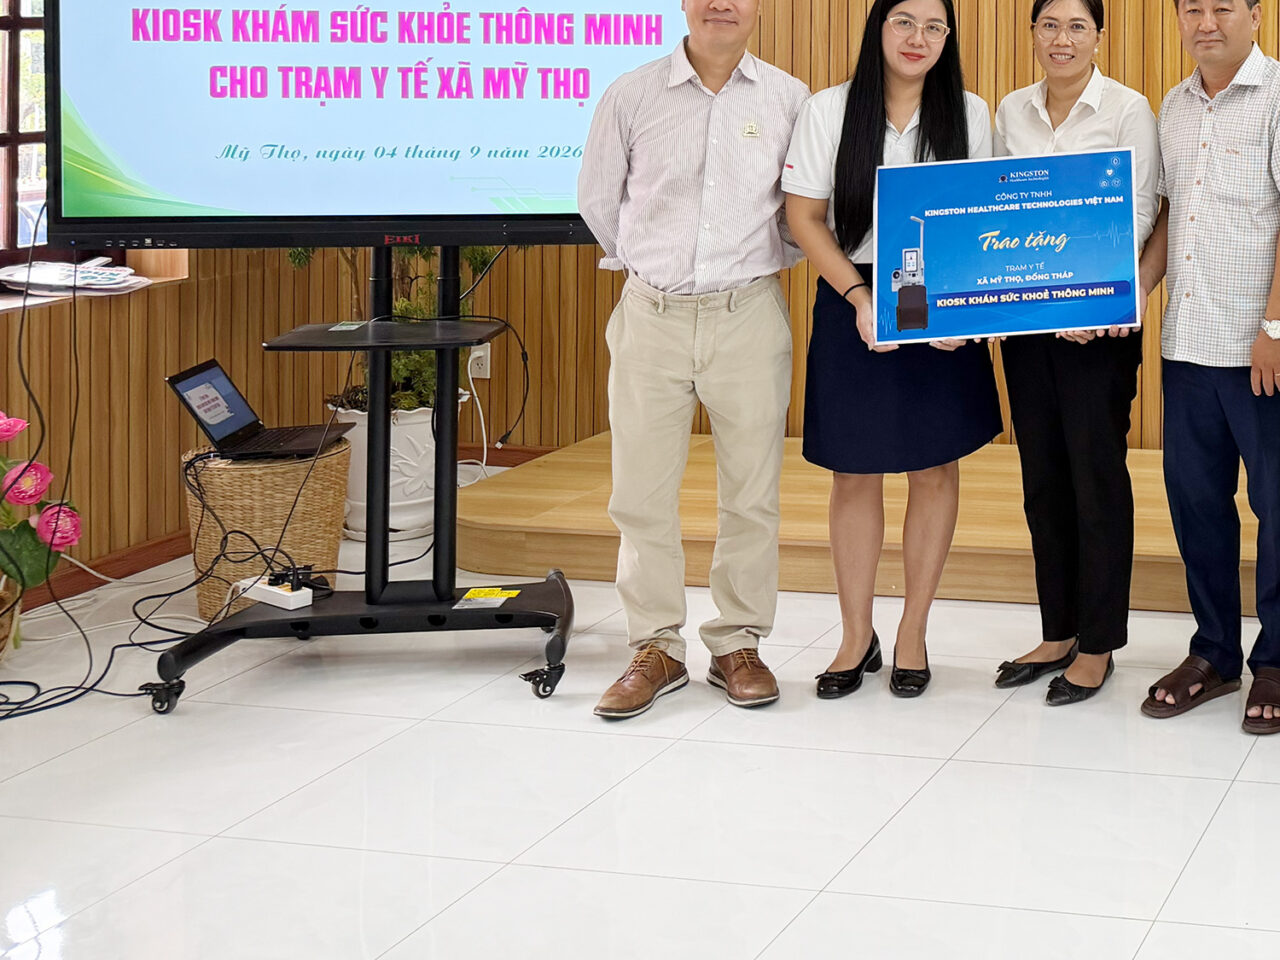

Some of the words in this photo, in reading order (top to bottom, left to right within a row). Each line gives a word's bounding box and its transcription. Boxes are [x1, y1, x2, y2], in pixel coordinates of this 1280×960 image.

[131, 8, 223, 42] KIOSK
[232, 4, 320, 42] KHÁM
[330, 4, 388, 44] SỨC
[398, 2, 471, 44] KHỎE
[478, 6, 574, 45] THÔNG
[584, 13, 662, 46] MINH
[209, 66, 268, 98] CHO
[277, 66, 362, 107] TRẠM
[370, 66, 389, 99] Y
[397, 56, 434, 99] TẾ
[436, 61, 474, 99] XÃ
[482, 61, 529, 99] MỸ
[536, 68, 590, 108] THỌ
[215, 144, 250, 162] Mỹ
[259, 144, 308, 162] Thọ,
[315, 146, 366, 162] ngày
[374, 145, 398, 159] 04
[404, 144, 461, 162] tháng
[470, 146, 481, 159] 9
[487, 146, 530, 159] năm
[536, 144, 583, 158] 2026
[1010, 169, 1049, 178] KINGSTON
[995, 192, 1018, 201] CÔNG
[1030, 190, 1052, 198] TNHH
[924, 208, 966, 217] KINGSTON
[968, 203, 1020, 214] HEALTHCARE
[1022, 198, 1084, 210] TECHNOLOGIES
[1084, 196, 1102, 206] VIỆT
[1104, 196, 1124, 204] NAM
[384, 234, 420, 245] EIKI
[978, 230, 1020, 252] Trao
[1025, 230, 1071, 253] tặng
[976, 276, 988, 285] XÃ
[990, 276, 1002, 284] MỸ
[1004, 276, 1024, 284] THỌ,
[1051, 270, 1074, 280] THÁP
[936, 296, 967, 308] KIOSK
[968, 294, 998, 306] KHÁM
[1000, 290, 1021, 304] SỨC
[1052, 286, 1087, 299] THÔNG
[1088, 286, 1114, 296] MINH
